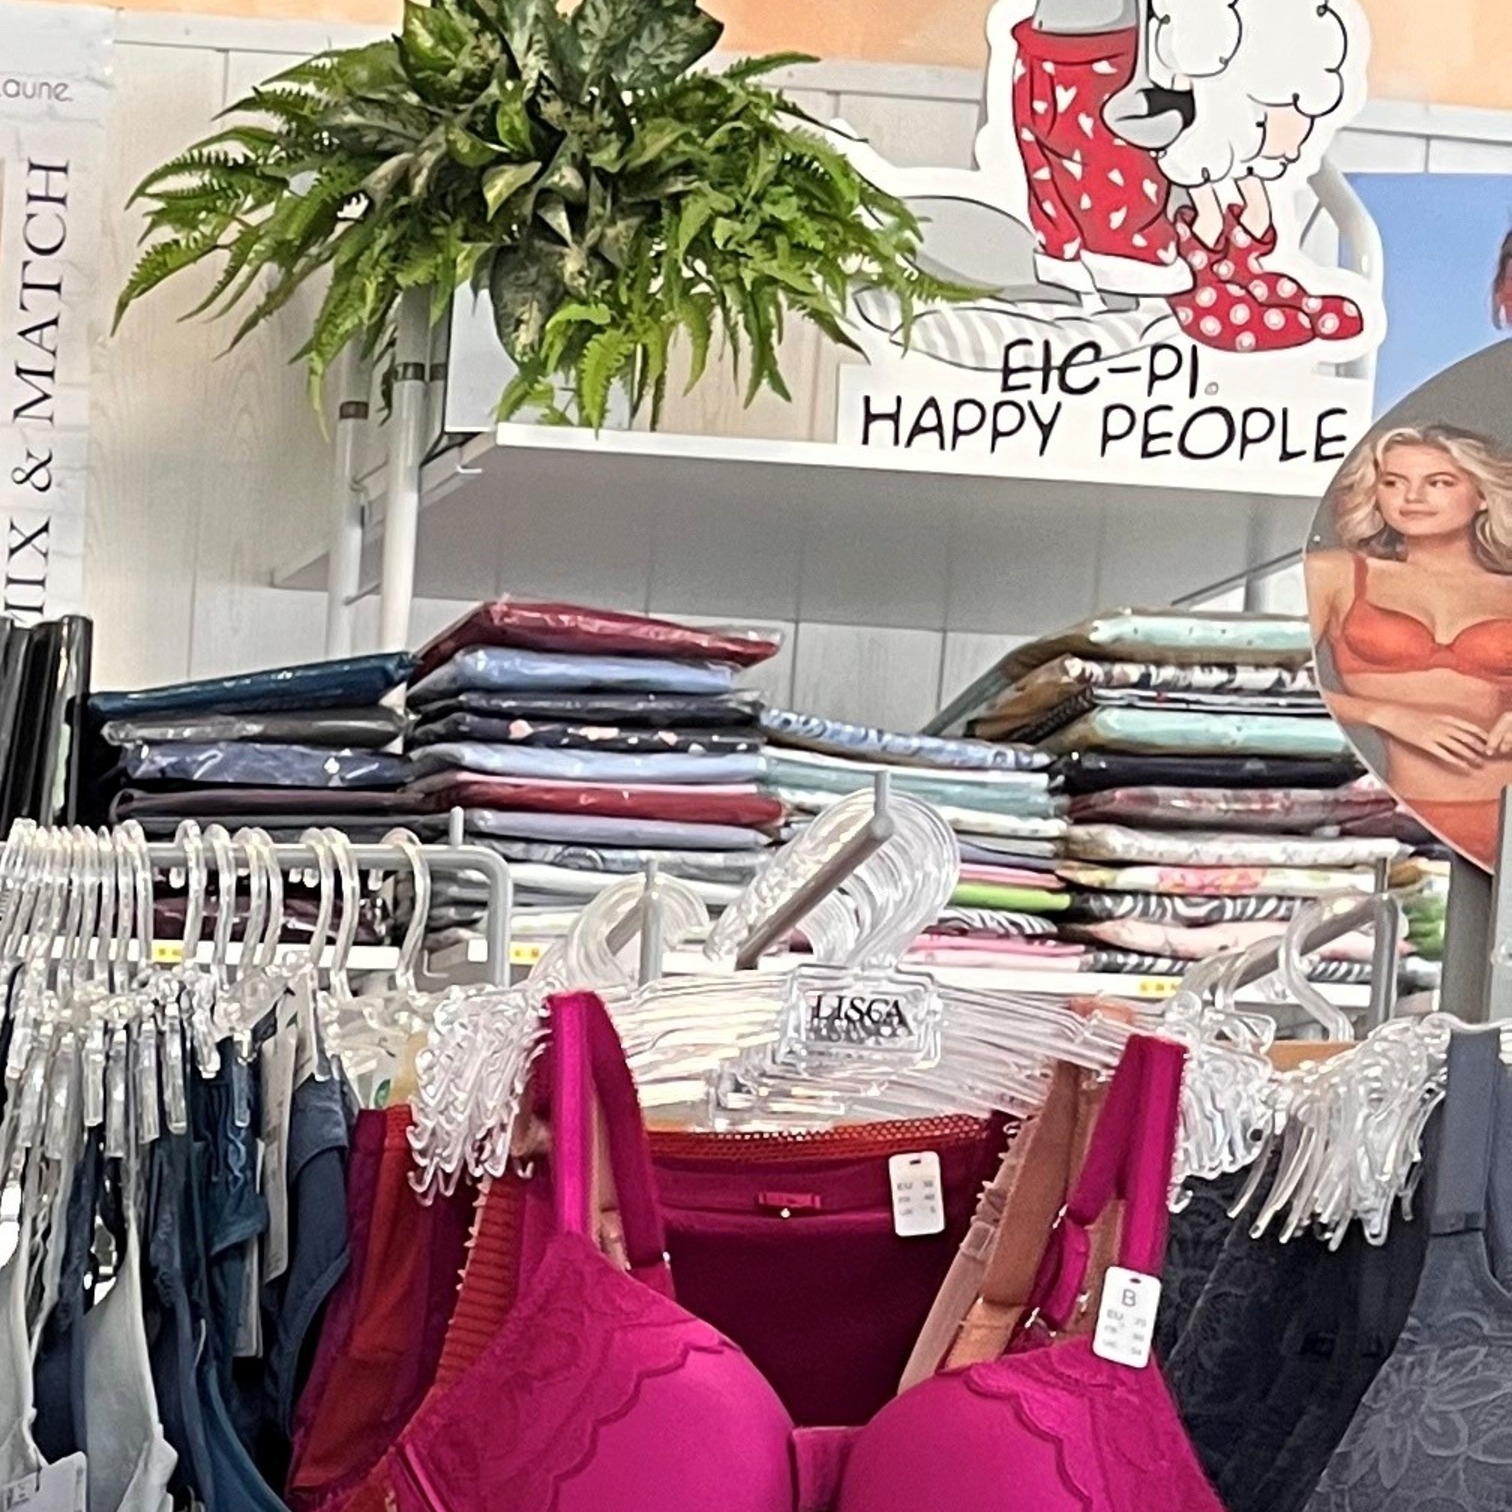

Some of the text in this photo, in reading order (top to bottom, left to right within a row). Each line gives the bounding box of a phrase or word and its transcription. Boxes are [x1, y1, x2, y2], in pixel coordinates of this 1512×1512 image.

[12, 156, 70, 426] MATCH
[861, 395, 1349, 462] HAPPY PEOPLE
[12, 447, 54, 493] &
[1121, 1288, 1136, 1308] B
